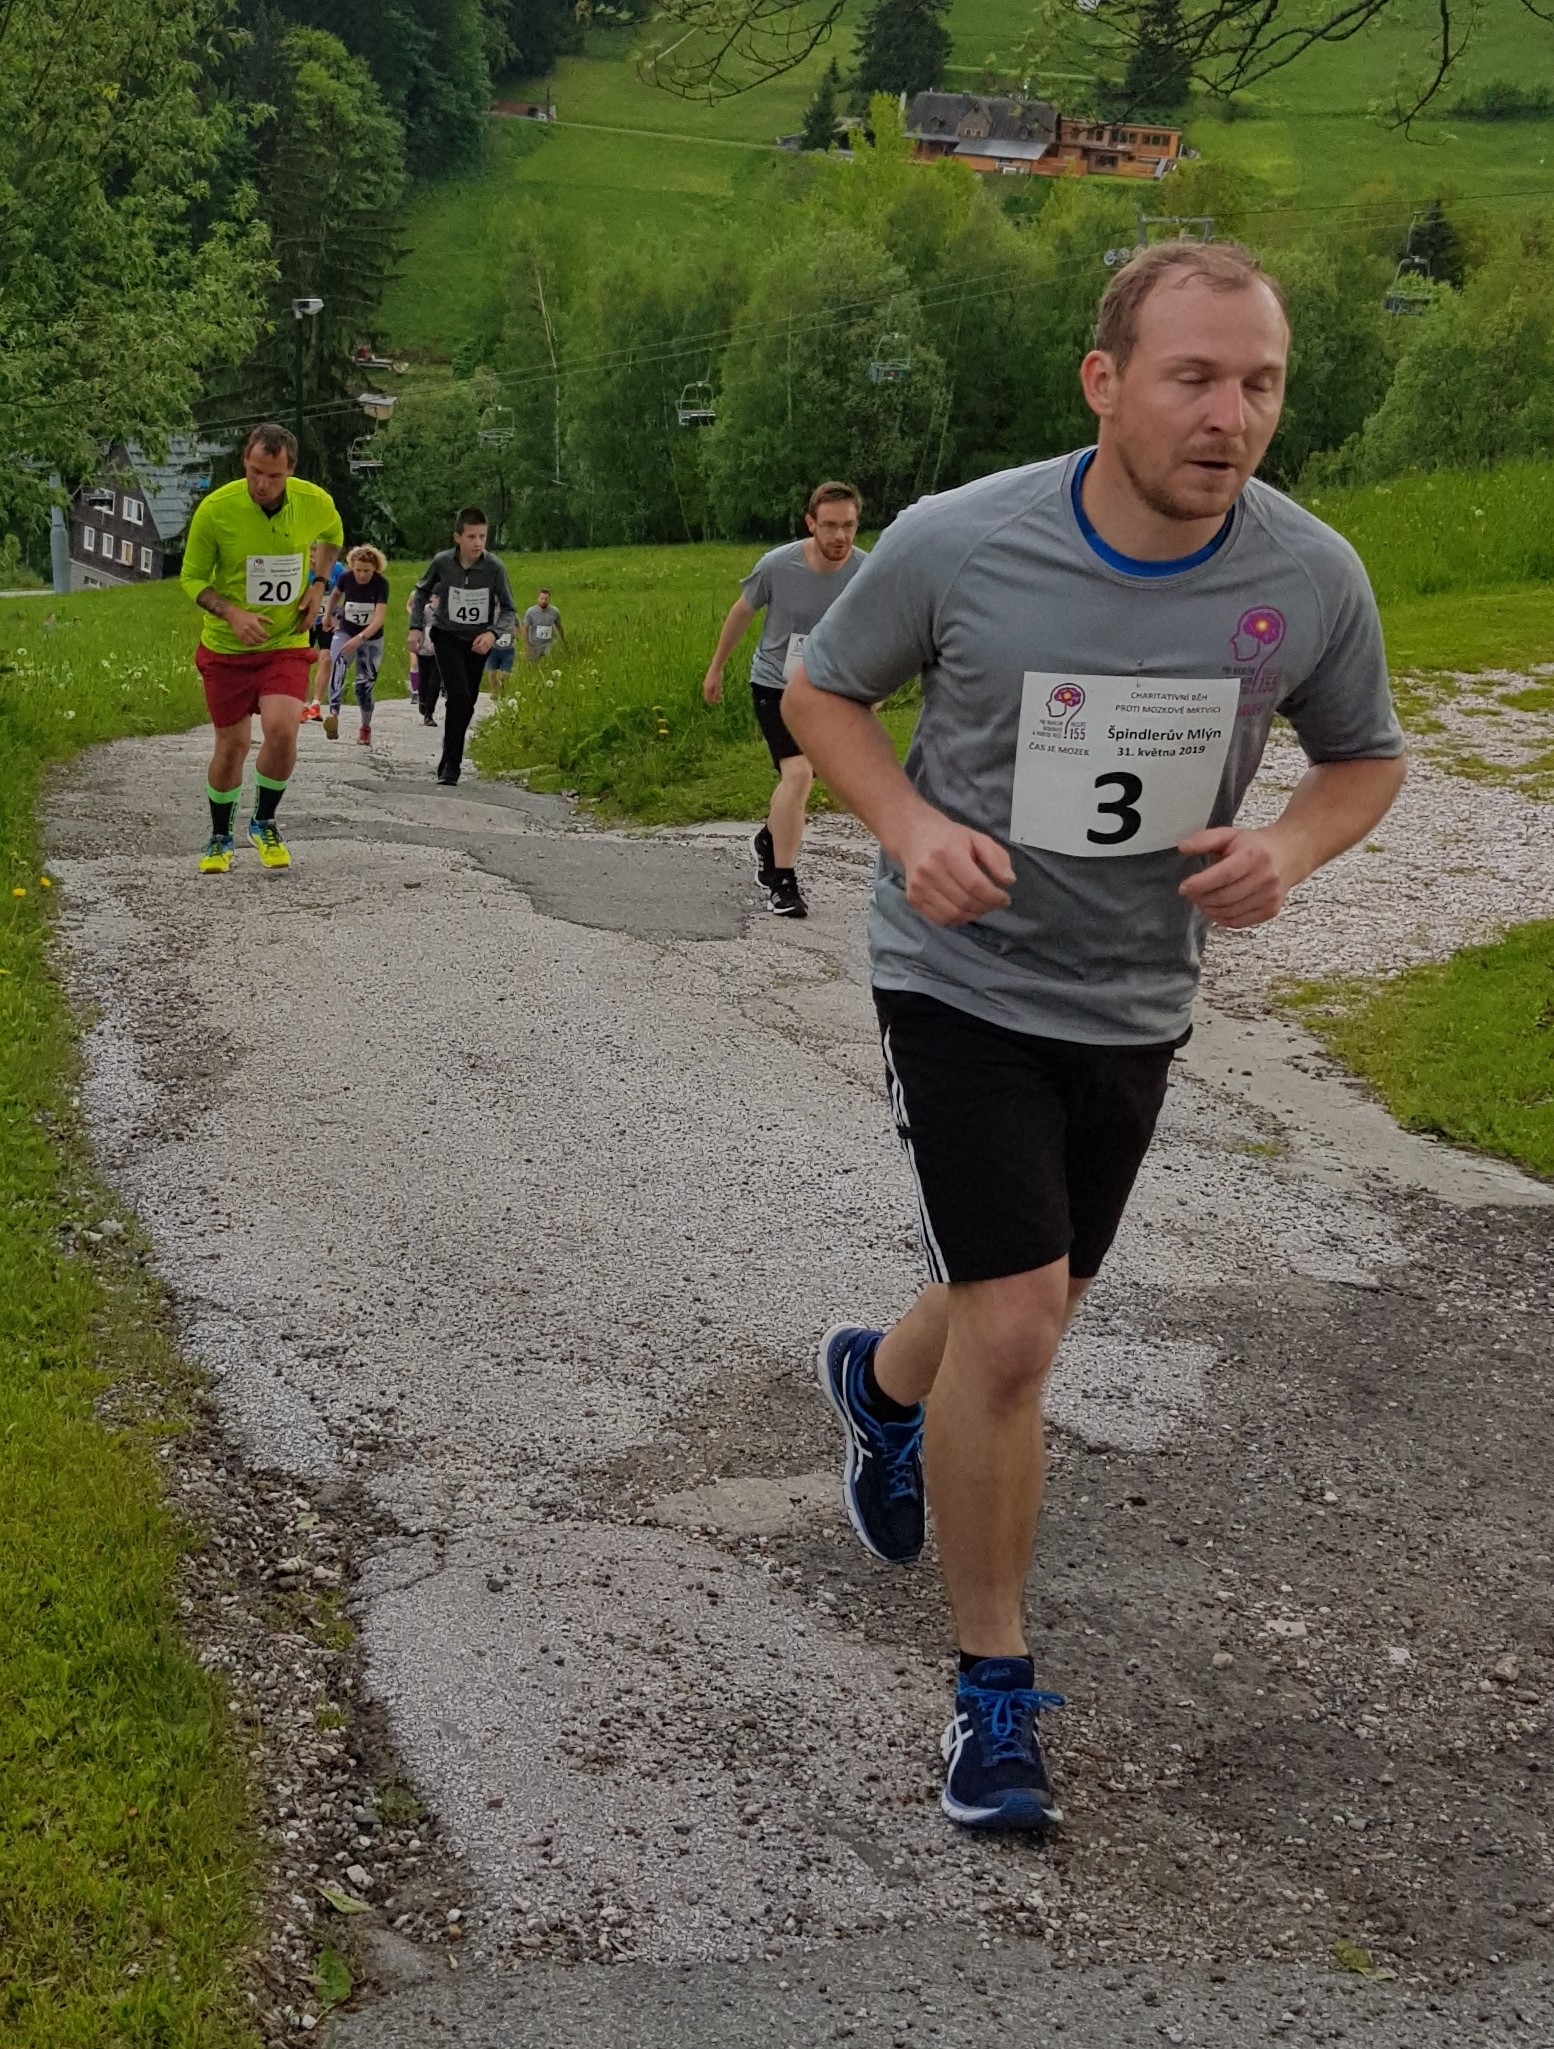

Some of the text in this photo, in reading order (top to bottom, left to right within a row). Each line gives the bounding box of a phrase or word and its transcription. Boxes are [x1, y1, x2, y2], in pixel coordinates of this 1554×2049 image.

[258, 581, 292, 602] 20
[352, 613, 369, 624] 37
[456, 606, 480, 622] 49
[1115, 704, 1141, 713] PROTI
[1070, 728, 1086, 740] 155
[1107, 724, 1222, 741] Špindlerův Mlýn
[1117, 745, 1206, 757] 31. května 2019
[1086, 771, 1143, 845] 3
